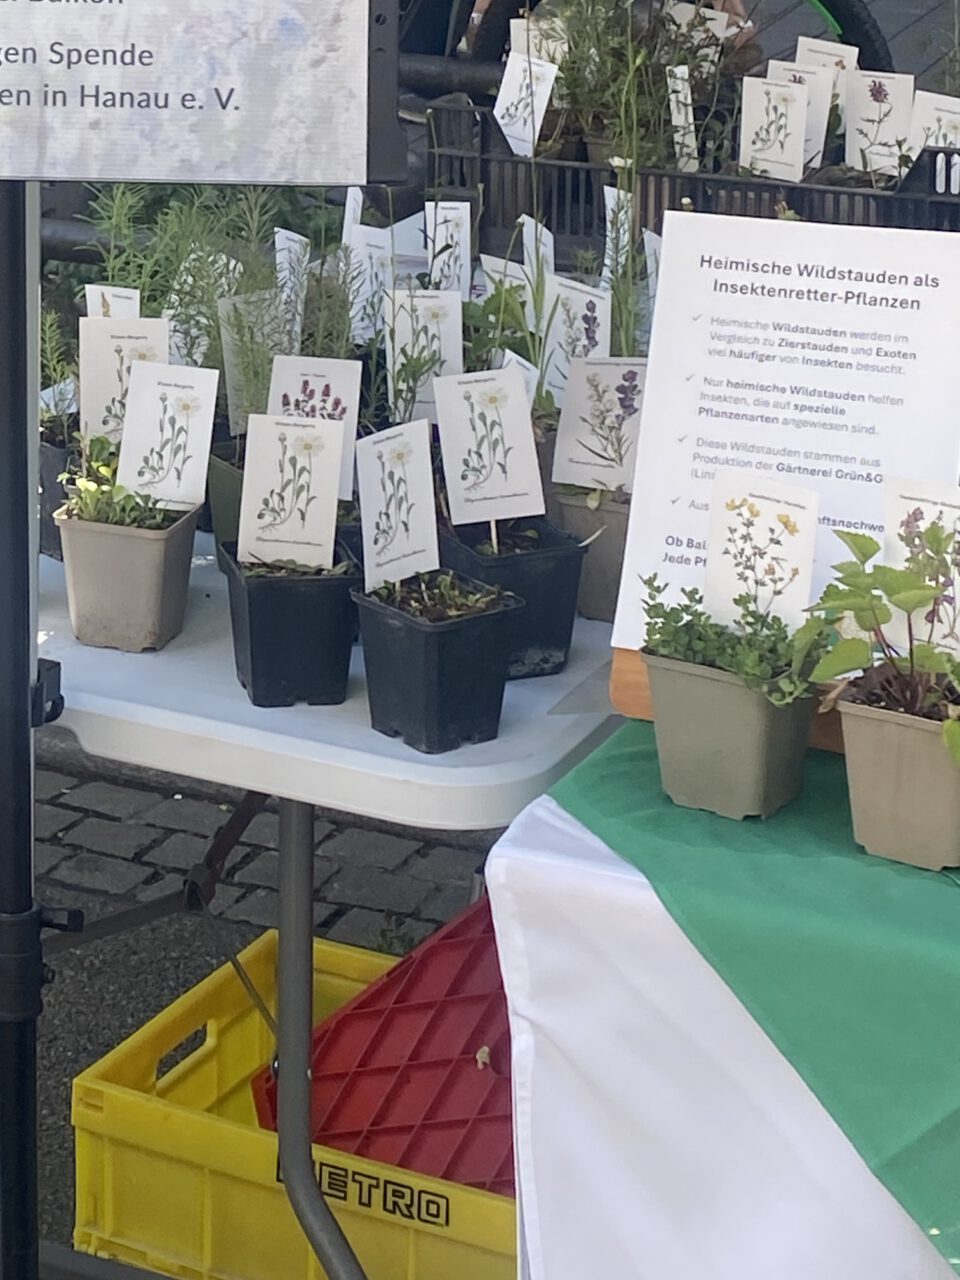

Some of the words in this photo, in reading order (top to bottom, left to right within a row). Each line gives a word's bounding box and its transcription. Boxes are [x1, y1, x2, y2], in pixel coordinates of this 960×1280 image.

[49, 41, 154, 70] Spende
[43, 83, 67, 107] in
[79, 84, 169, 110] Hanau
[181, 92, 204, 110] e.
[214, 87, 241, 111] V.
[700, 255, 792, 276] Heimische
[797, 263, 909, 286] Wildstauden
[913, 272, 940, 288] als
[713, 279, 921, 311] Insektenretter-Pflanzen
[710, 316, 770, 331] Heimische
[772, 322, 847, 338] Wildstauden
[729, 349, 777, 364] häufiger
[801, 356, 853, 370] Insekten
[762, 338, 775, 347] zu
[777, 337, 849, 354] Zierstauden
[851, 345, 873, 357] und
[876, 347, 917, 361] Exoten
[703, 376, 724, 388] Nur
[726, 379, 787, 394] heimische
[789, 385, 865, 402] Wildstauden
[698, 406, 779, 425] Pflanzenarten
[781, 416, 849, 433] angewiesen
[793, 402, 846, 417] spezielle
[696, 437, 728, 451] Diese
[730, 441, 801, 460] Wildstauden
[803, 451, 857, 466] stammen
[859, 457, 881, 468] aus
[692, 453, 753, 469] Produktion
[755, 460, 774, 471] der
[776, 461, 833, 479] Gärtnerei
[835, 469, 884, 485] Grün&G
[665, 535, 684, 548] Ob
[686, 537, 709, 551] Bal
[662, 552, 692, 567] Jede
[276, 1152, 450, 1227] ETRO
